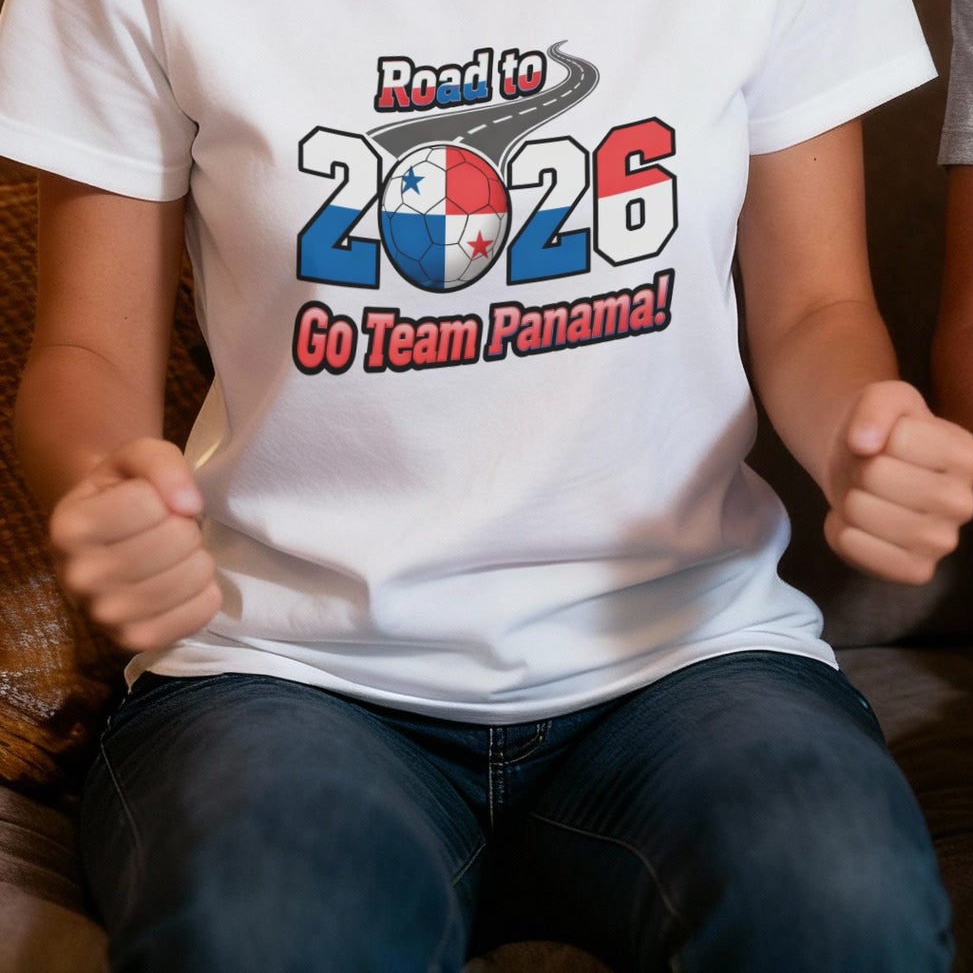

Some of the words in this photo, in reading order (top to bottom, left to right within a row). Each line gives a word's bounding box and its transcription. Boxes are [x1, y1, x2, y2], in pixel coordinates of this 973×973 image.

[374, 47, 493, 112] Road
[498, 48, 547, 100] to
[292, 301, 358, 375] Go
[363, 307, 482, 373] Team
[483, 268, 675, 365] Panama!
